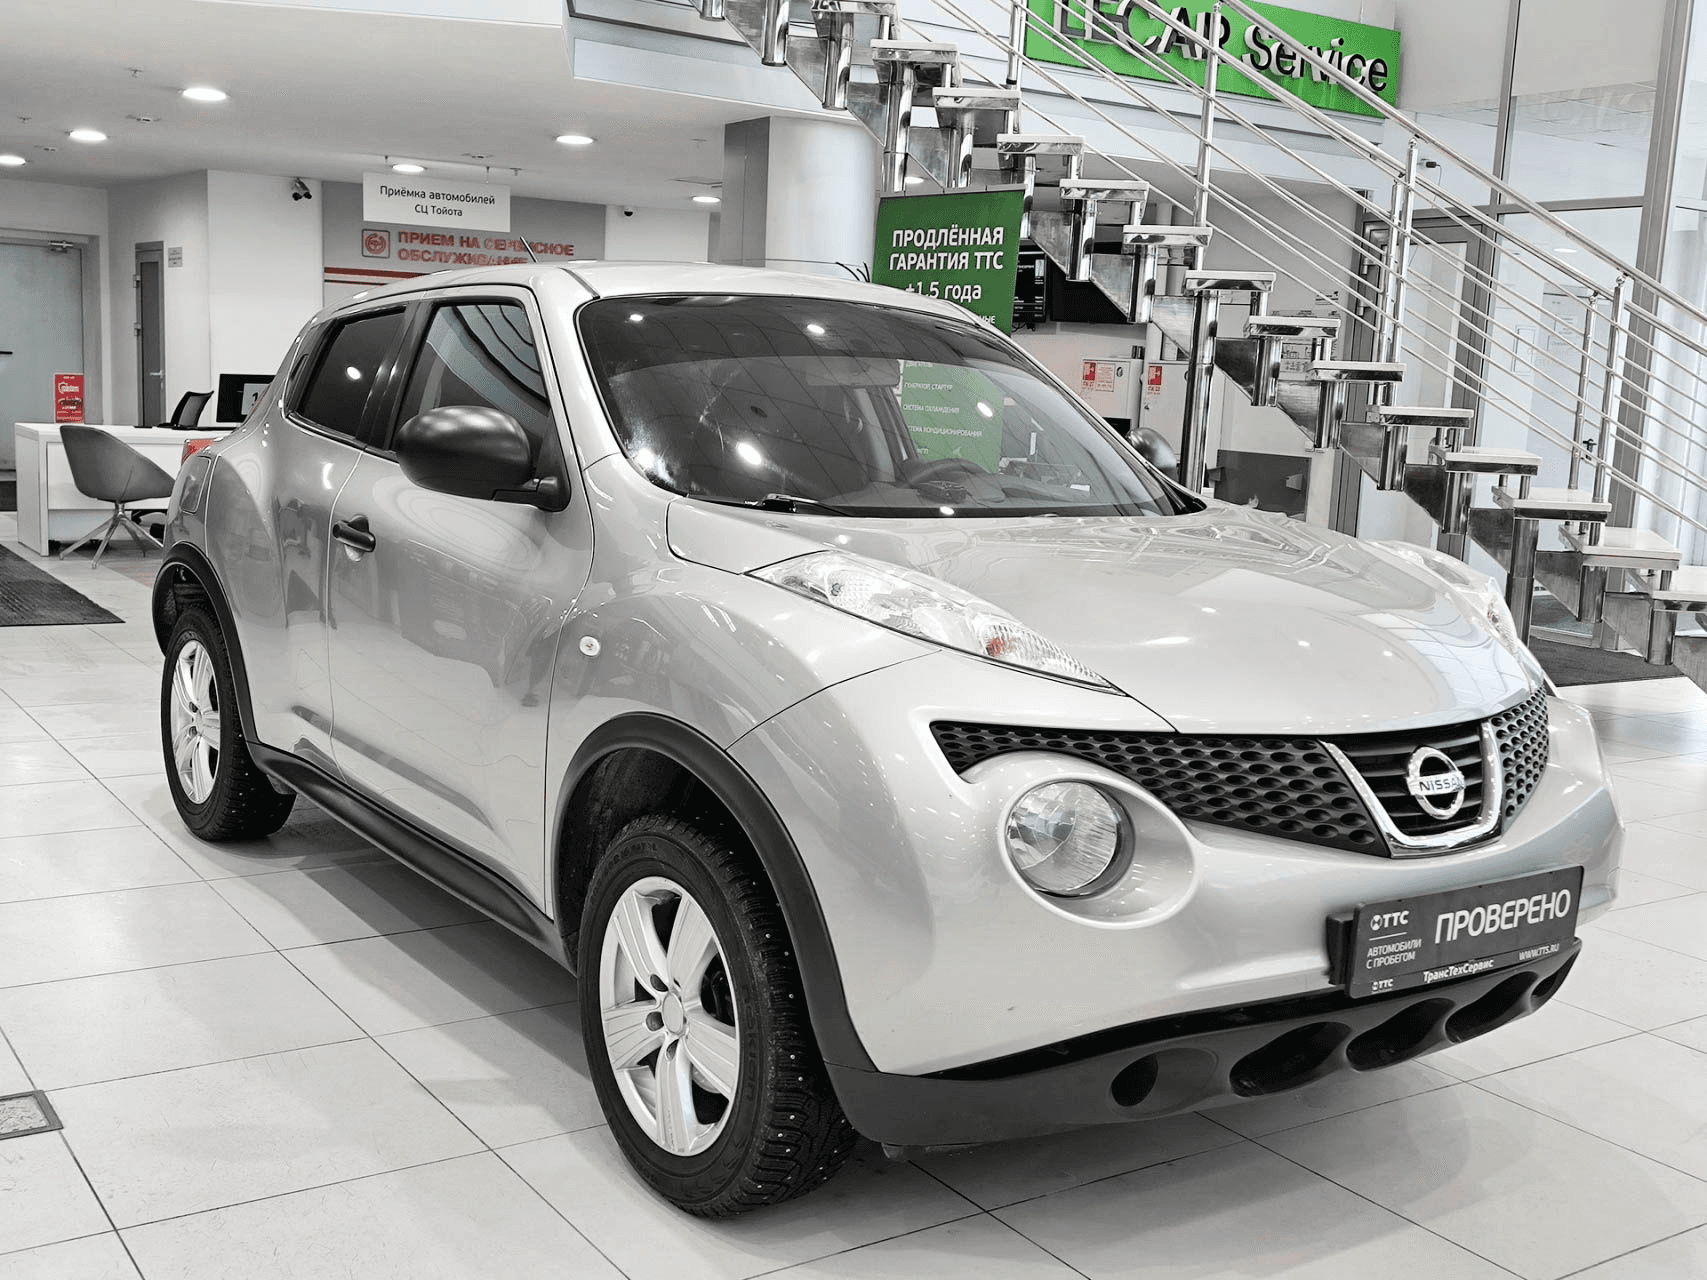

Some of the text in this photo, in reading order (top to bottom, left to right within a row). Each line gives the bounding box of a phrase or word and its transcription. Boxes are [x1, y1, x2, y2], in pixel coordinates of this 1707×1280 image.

[1242, 23, 1389, 93] Service
[380, 185, 496, 205] Приёмка автомобилей
[414, 204, 463, 217] СЦ Тойота
[398, 231, 454, 247] ПРИЕМ
[460, 236, 480, 249] НА
[892, 224, 1004, 250] ПРОДЛЁННАЯ
[889, 252, 970, 271] ГАРАНТИЯ
[974, 251, 1004, 270] ТТС
[944, 284, 982, 303] года
[1382, 910, 1410, 928] ТТС
[1434, 889, 1571, 944] ПРОВЕРЕНО
[1367, 938, 1422, 958] АВТОМОБИЛИ
[1366, 950, 1416, 969] С ПРОБЕГОМ
[1423, 959, 1494, 983] ТрансТехСервис
